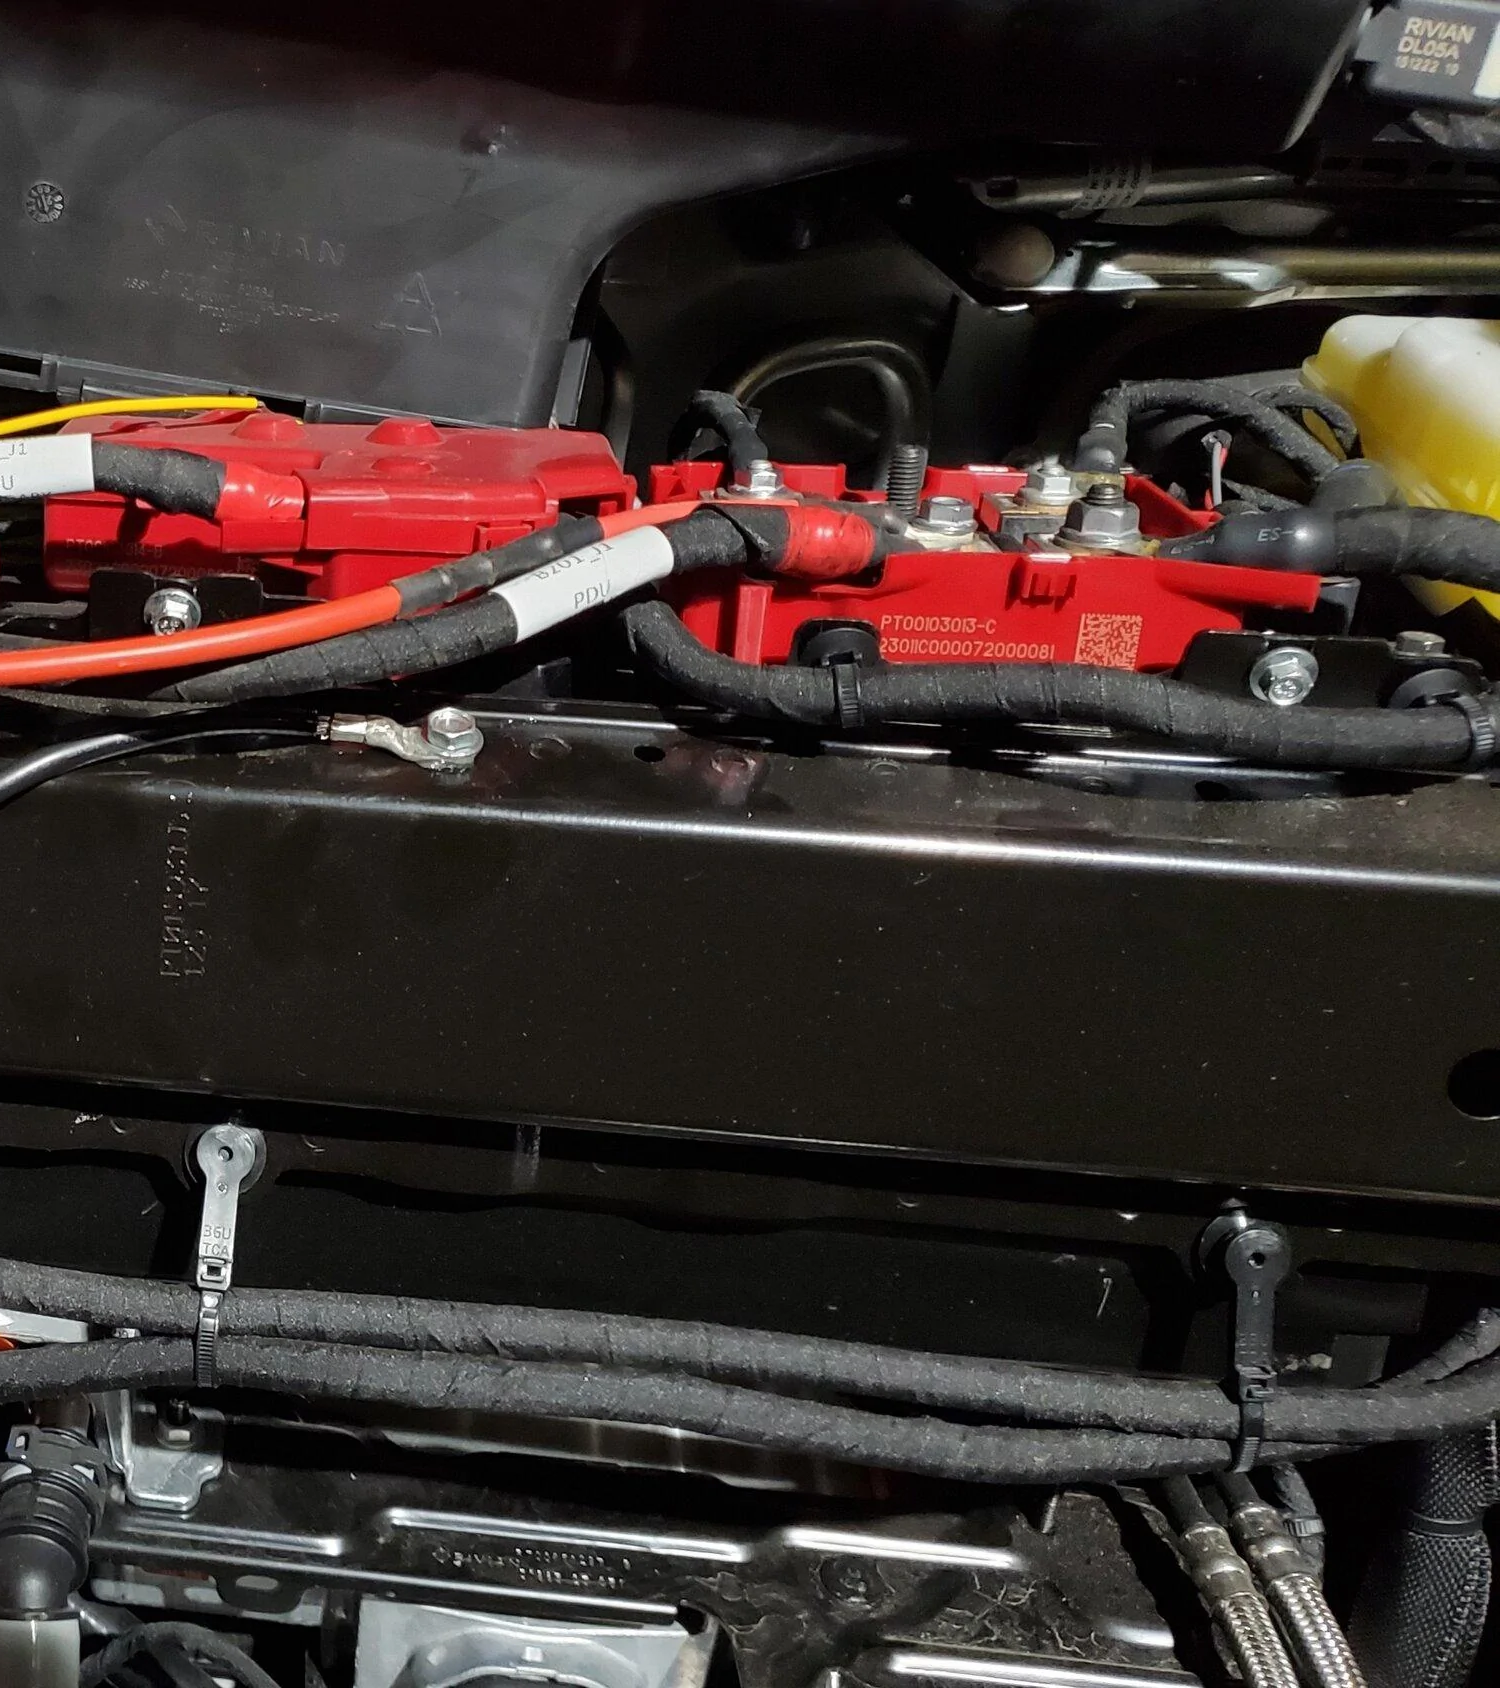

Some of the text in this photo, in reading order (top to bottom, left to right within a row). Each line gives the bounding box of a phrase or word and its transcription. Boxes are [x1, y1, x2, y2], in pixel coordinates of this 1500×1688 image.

[1405, 16, 1476, 44] RIVIAN
[574, 579, 612, 610] PDU
[880, 614, 998, 634] PT00103013-C
[203, 1242, 230, 1257] TCA
